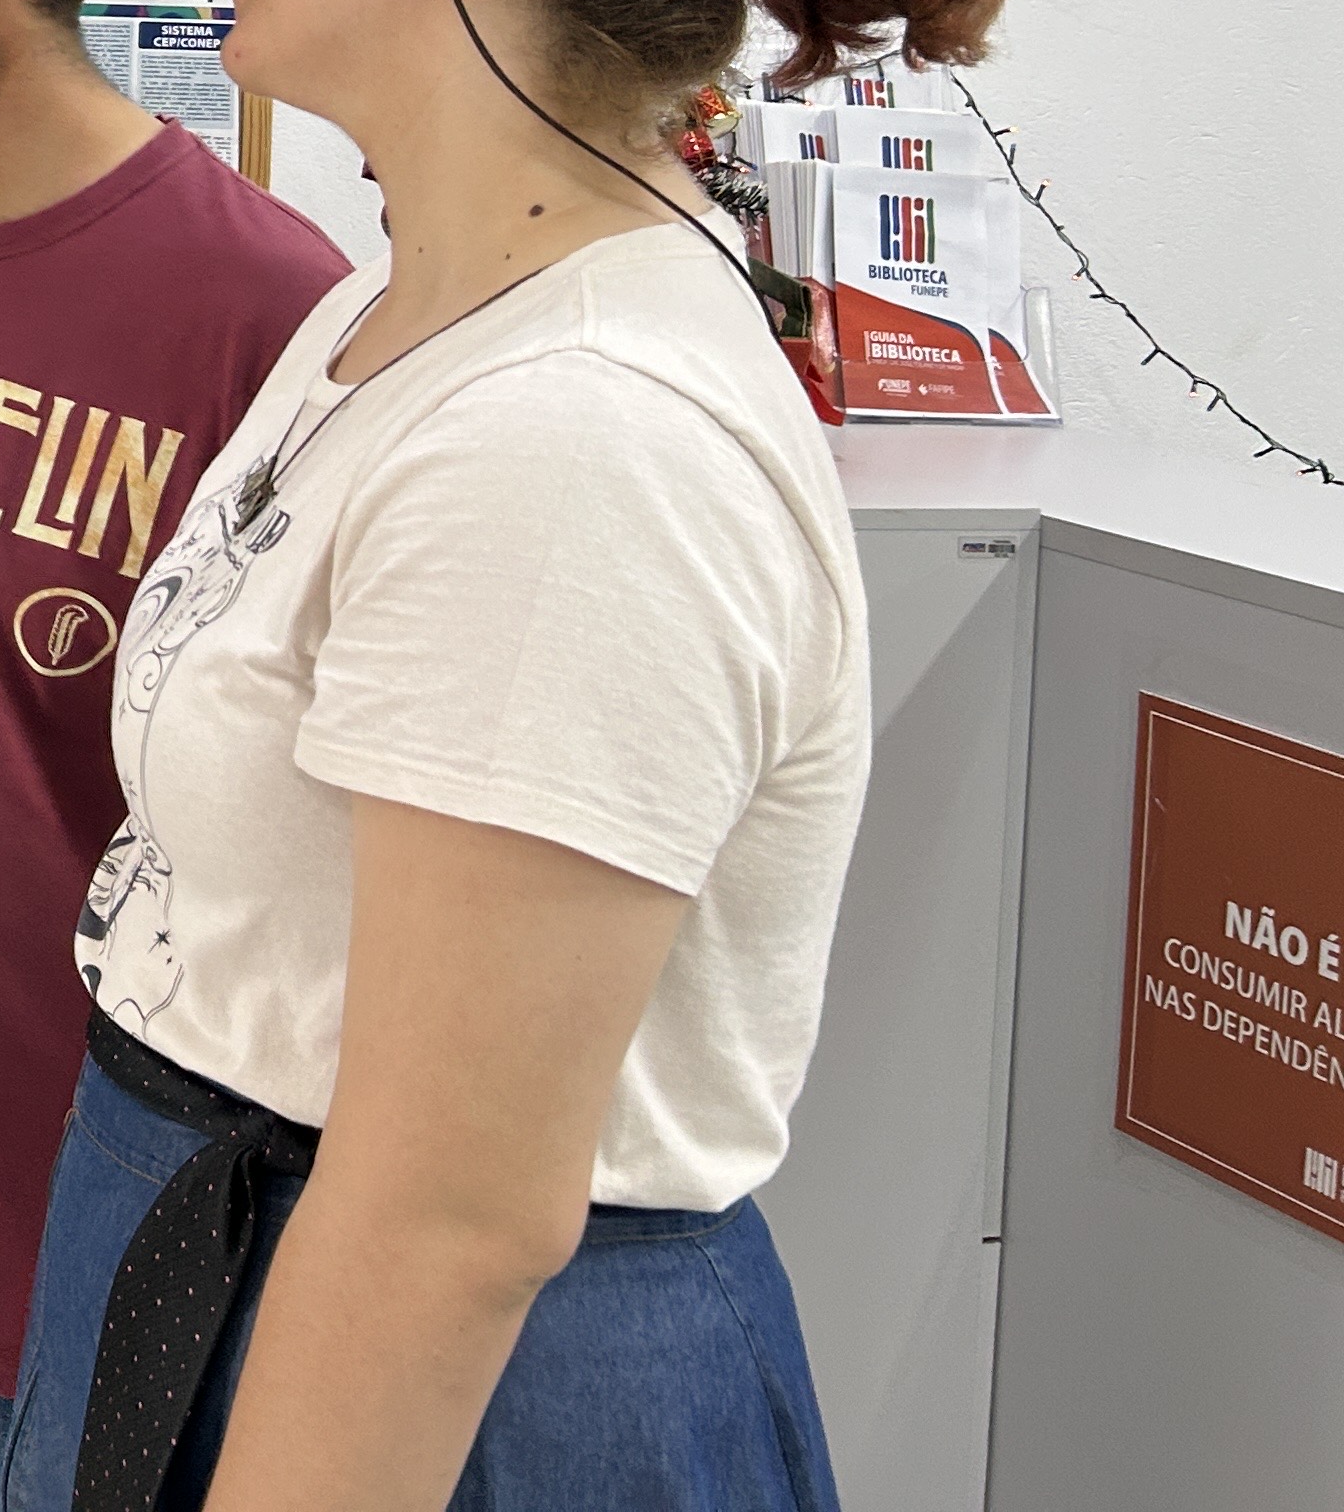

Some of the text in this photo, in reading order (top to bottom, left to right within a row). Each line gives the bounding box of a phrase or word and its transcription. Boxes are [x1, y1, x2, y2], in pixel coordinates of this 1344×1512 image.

[162, 25, 213, 35] SISTEMA
[153, 37, 220, 48] CEP/CONEP
[869, 265, 947, 284] BIBLIOTECA
[911, 285, 948, 298] FUNEPE
[870, 331, 914, 344] GUIA DA
[872, 343, 963, 364] BIBLIOTECA
[1225, 901, 1340, 982] NÃO É
[1164, 937, 1344, 1041] CONSUMIR AL
[1145, 974, 1344, 1089] NAS DEPENDÊN
